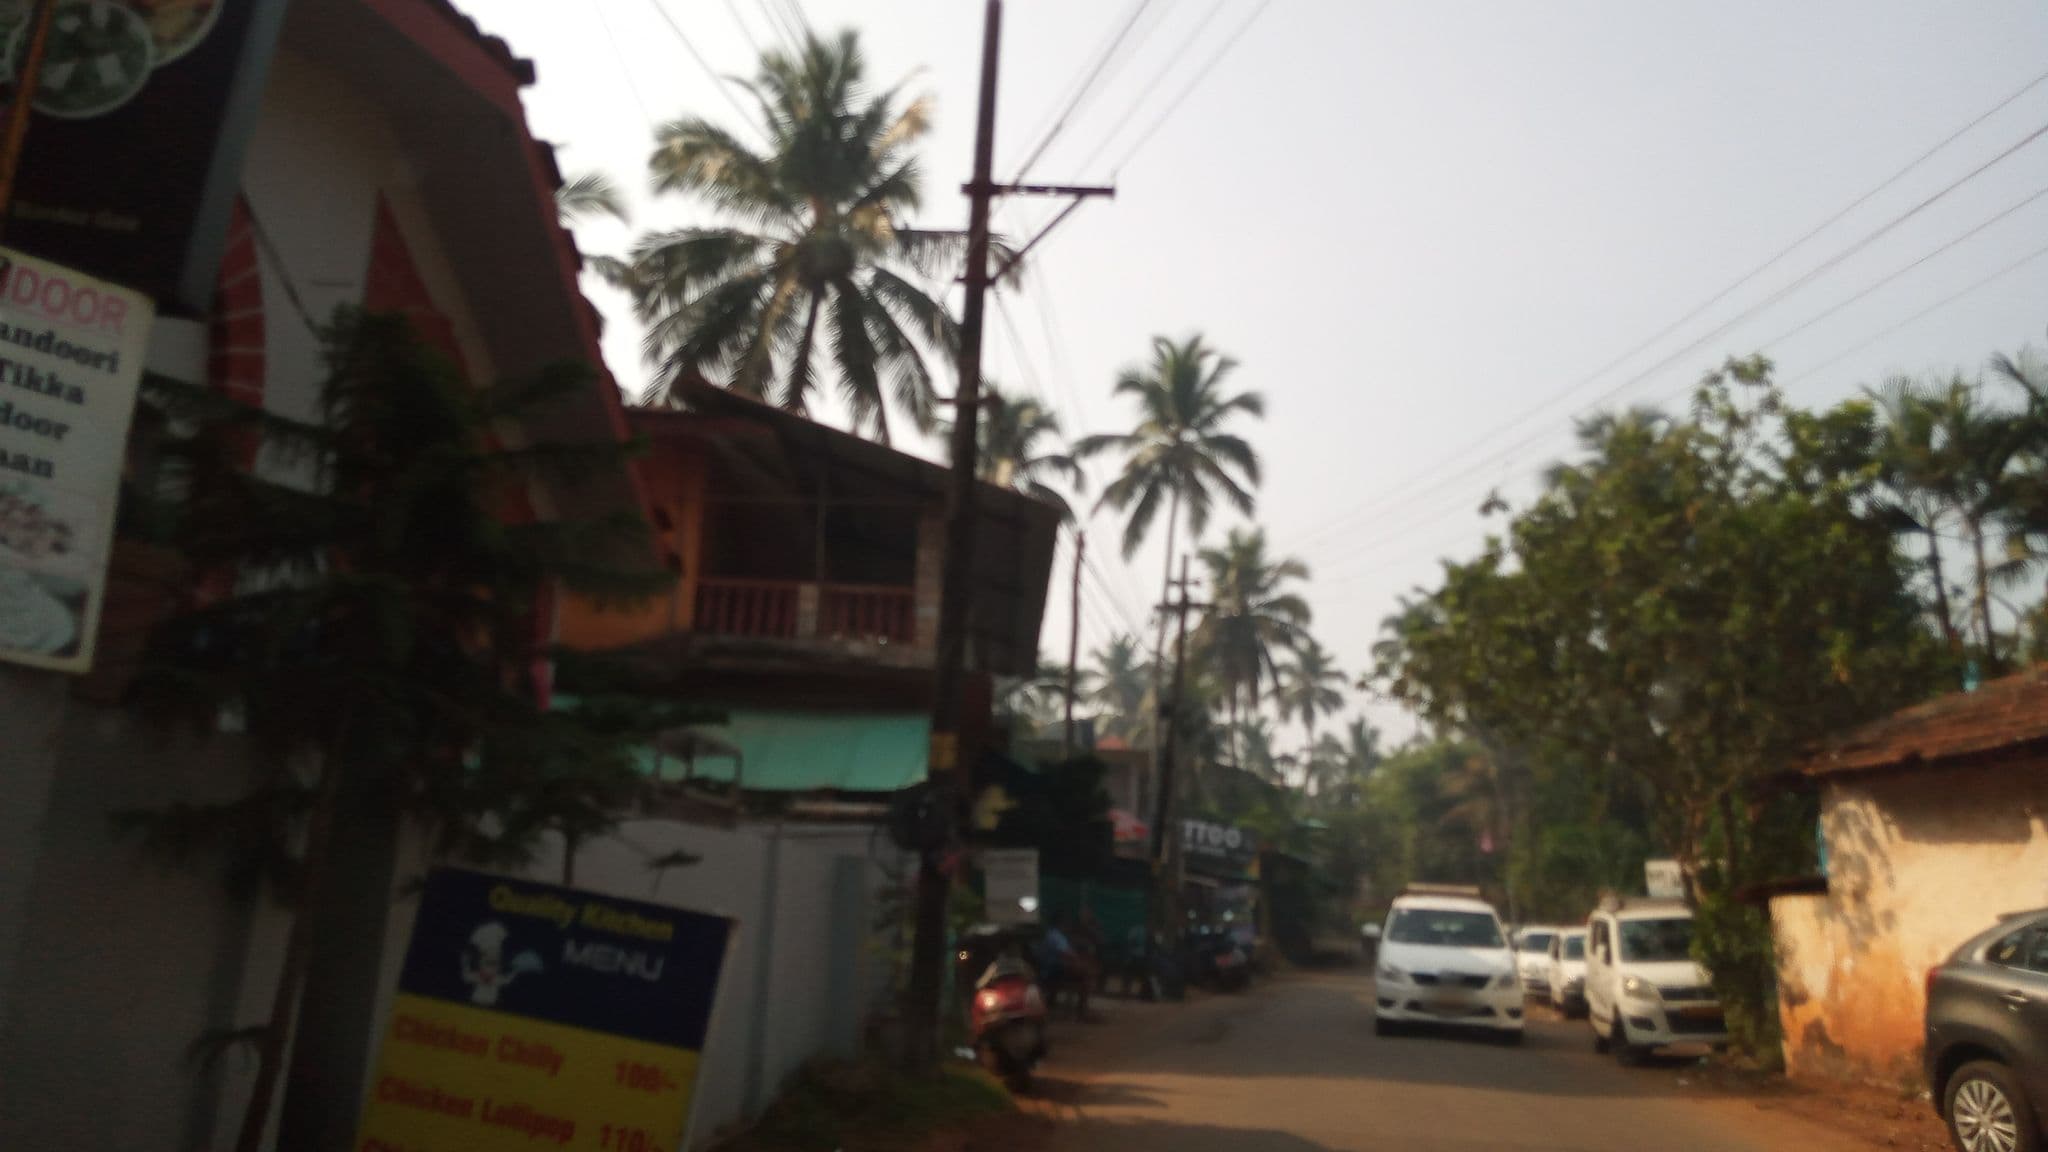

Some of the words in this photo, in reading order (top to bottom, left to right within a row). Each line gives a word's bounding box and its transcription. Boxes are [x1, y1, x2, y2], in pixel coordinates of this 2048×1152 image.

[562, 940, 664, 982] MENU
[394, 1015, 489, 1055] Chicken
[377, 1076, 475, 1119] Chicken
